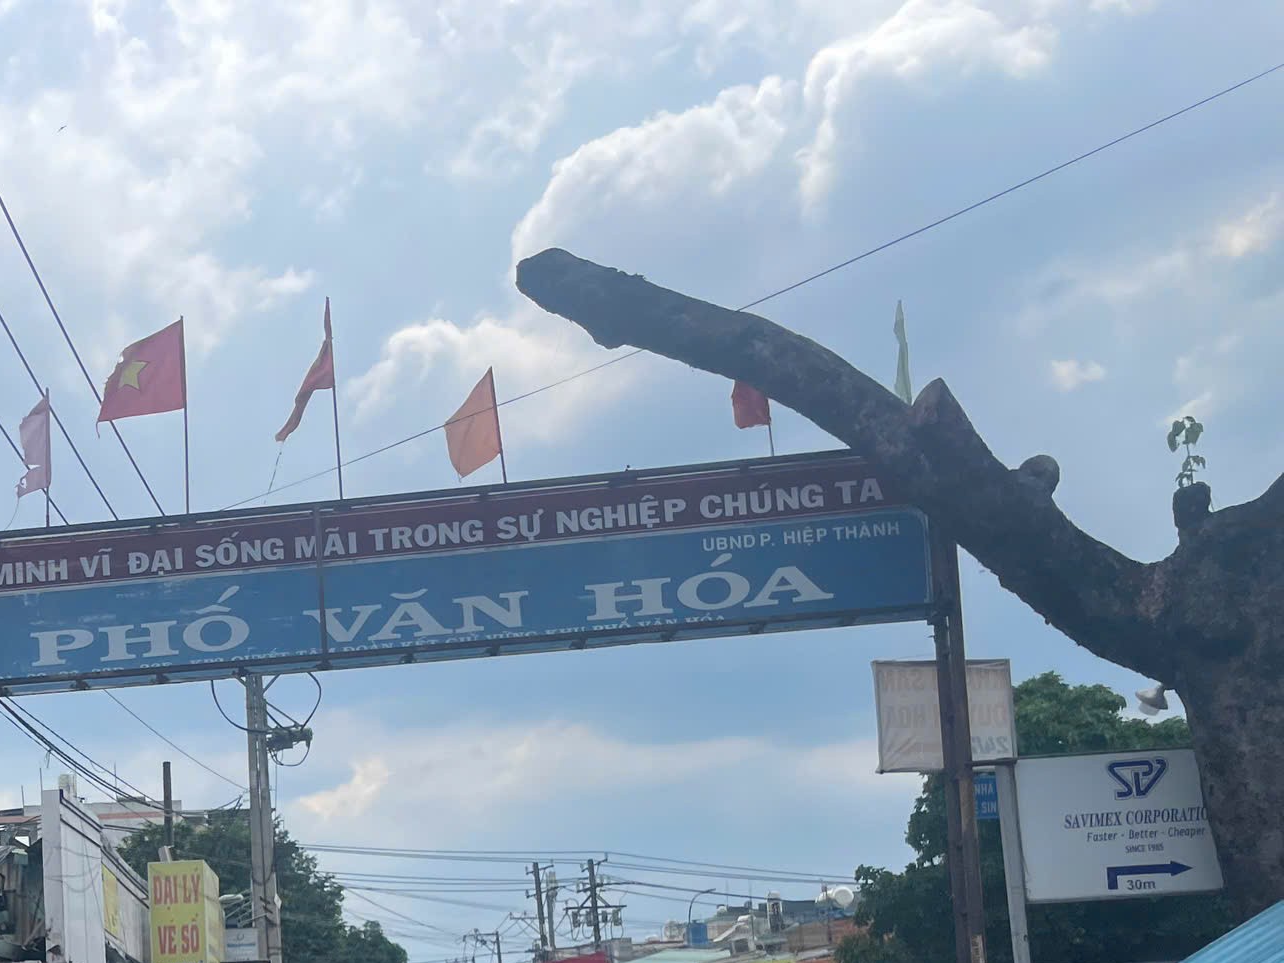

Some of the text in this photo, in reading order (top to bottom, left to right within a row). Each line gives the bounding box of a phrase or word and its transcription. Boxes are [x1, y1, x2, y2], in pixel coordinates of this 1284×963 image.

[80, 546, 112, 578] VĨ
[127, 545, 184, 579] ĐẠI
[195, 531, 287, 569] SỐNG
[295, 524, 358, 561] MÃI
[368, 518, 485, 553] TRONG
[496, 509, 541, 543] SỰ
[555, 494, 688, 536] NGHIỆP
[698, 476, 826, 520] CHÚNG
[834, 476, 885, 504] TA
[701, 531, 755, 553] UBND
[783, 523, 829, 547] HIỆP
[833, 517, 901, 540] THÀNH
[29, 585, 251, 667] PHỐ
[301, 588, 530, 645] VĂN
[584, 554, 834, 622] HÓA
[1063, 810, 1124, 830] SAVIMEX
[1086, 830, 1118, 843] Faster
[1127, 828, 1159, 840] Better
[153, 867, 201, 911] ĐẠI LÝ
[1126, 878, 1157, 890] 30m
[157, 913, 201, 955] VÉ SỐ
